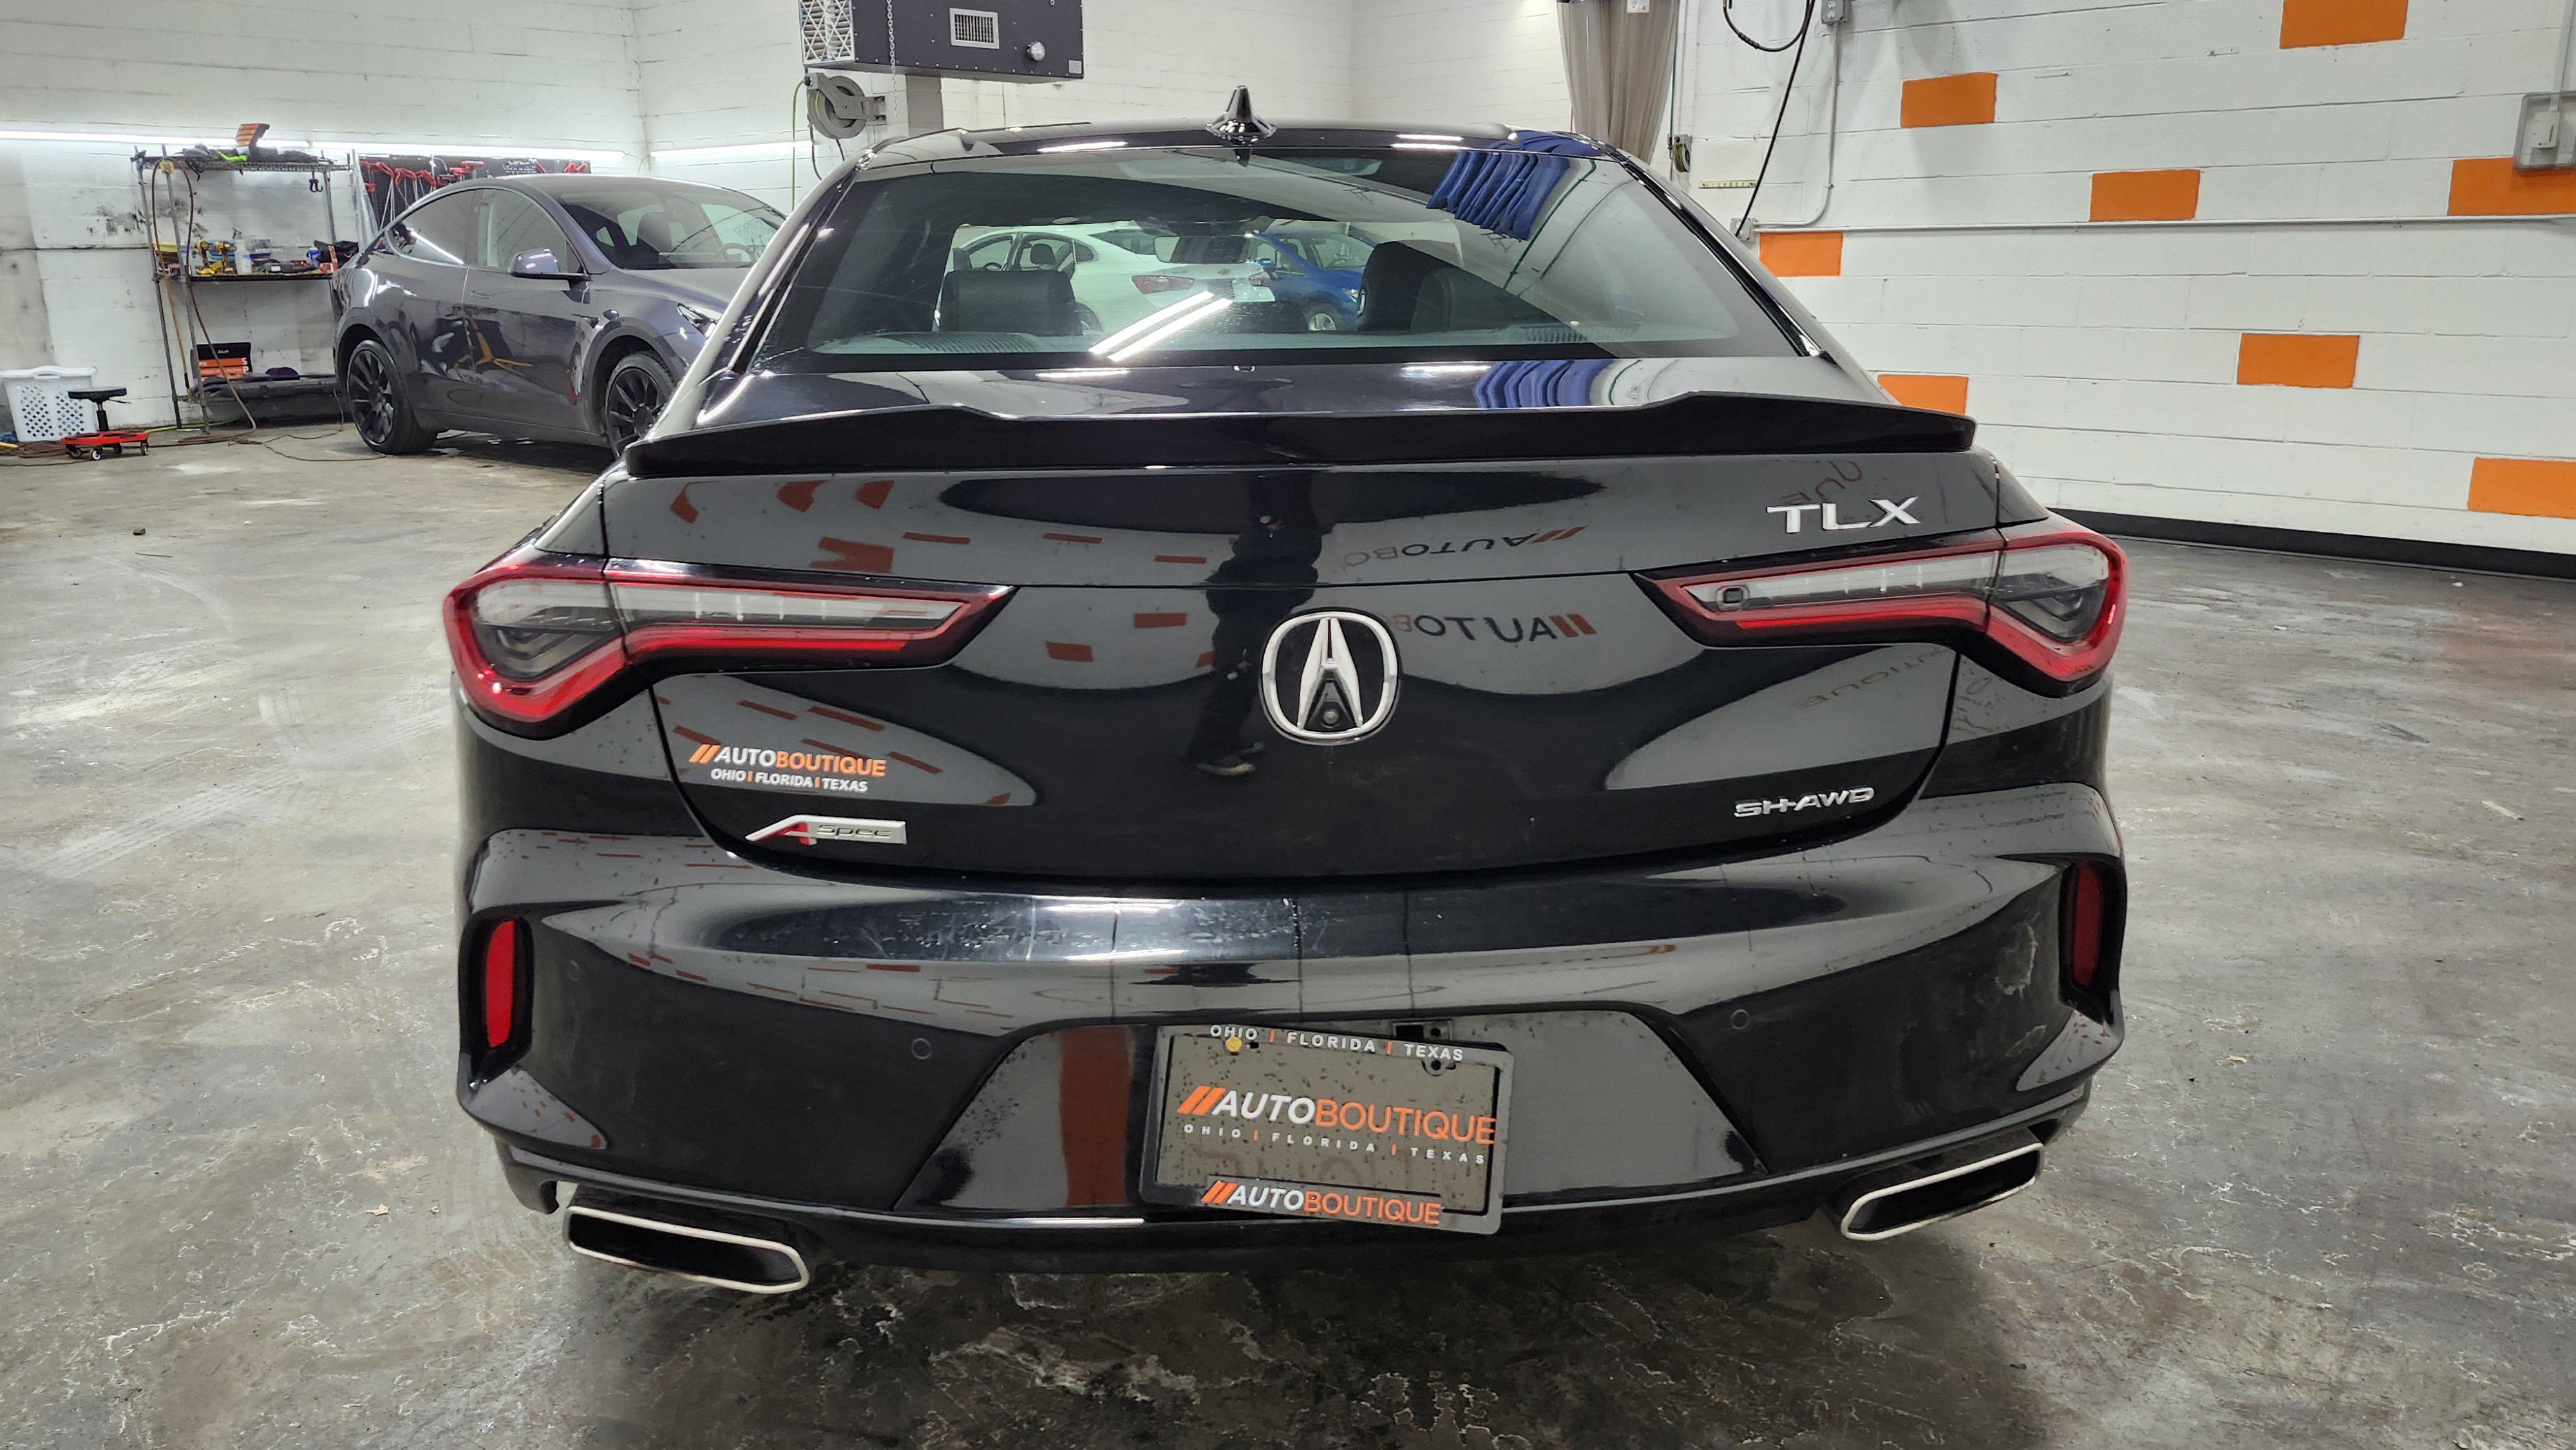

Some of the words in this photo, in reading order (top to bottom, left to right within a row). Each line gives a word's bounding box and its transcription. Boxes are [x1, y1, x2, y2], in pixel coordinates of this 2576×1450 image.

[1766, 496, 1921, 534] TLX
[710, 768, 746, 783] OHIO
[755, 771, 813, 789] FLORIDA
[821, 777, 868, 793] TEXAS
[713, 746, 887, 777] AUTOBOUTIQUE
[1209, 1024, 1258, 1040] OHIO
[1287, 1031, 1376, 1053] FLORIDA
[1403, 1042, 1464, 1062] TEXAS
[1212, 1089, 1497, 1145] AUTOBOUTIQUE
[1183, 1123, 1242, 1139] OHIO
[1271, 1132, 1375, 1153] FLORIDA
[1410, 1147, 1484, 1165] TEXAS
[1226, 1184, 1442, 1226] AUTOBOUTIQUE
